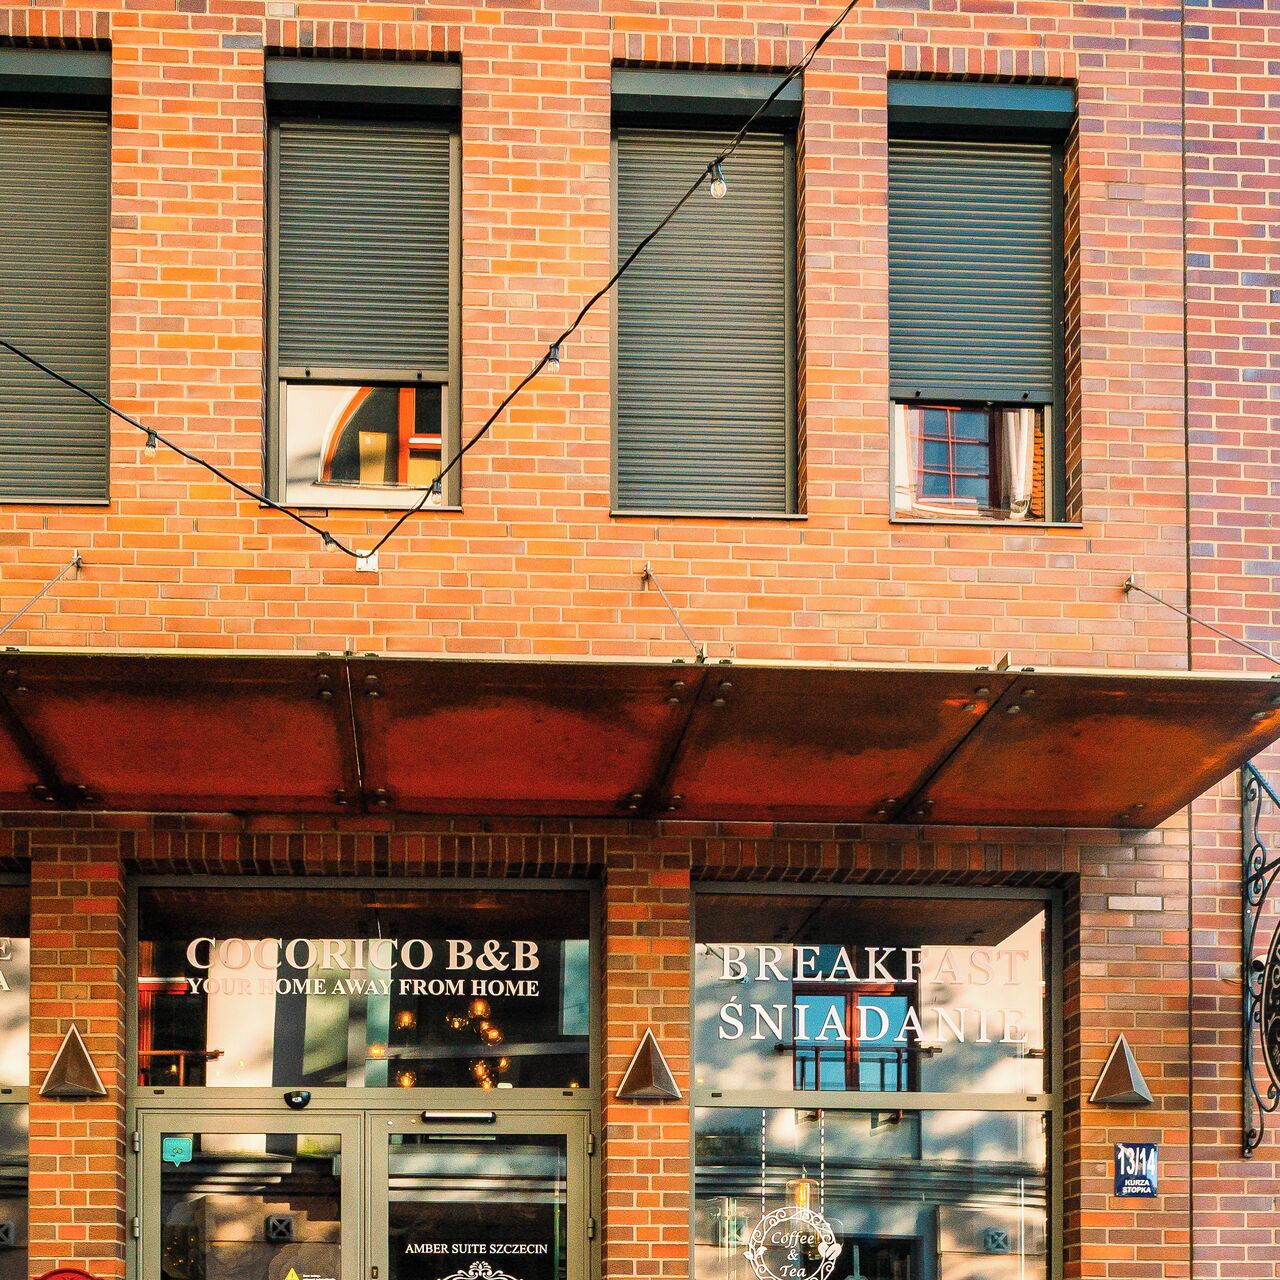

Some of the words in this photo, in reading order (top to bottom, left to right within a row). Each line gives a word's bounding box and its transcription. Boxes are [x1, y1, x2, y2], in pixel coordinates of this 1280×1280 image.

[186, 937, 433, 971] COCORICO
[445, 939, 540, 972] B&B
[719, 945, 1029, 986] BREAKFAST
[187, 977, 253, 995] YOUR
[258, 977, 326, 995] HOME
[331, 978, 395, 996] AWAY
[399, 978, 464, 996] FROM
[471, 979, 540, 997] HOME
[718, 996, 1029, 1044] ŚNIADANIE
[1118, 1147, 1155, 1175] 13/14
[405, 1243, 449, 1254] AMBER
[452, 1243, 486, 1254] SUITE
[489, 1244, 548, 1254] SZCZECIN
[771, 1231, 814, 1248] Coffee
[787, 1249, 798, 1260] &
[779, 1264, 806, 1277] Tea
